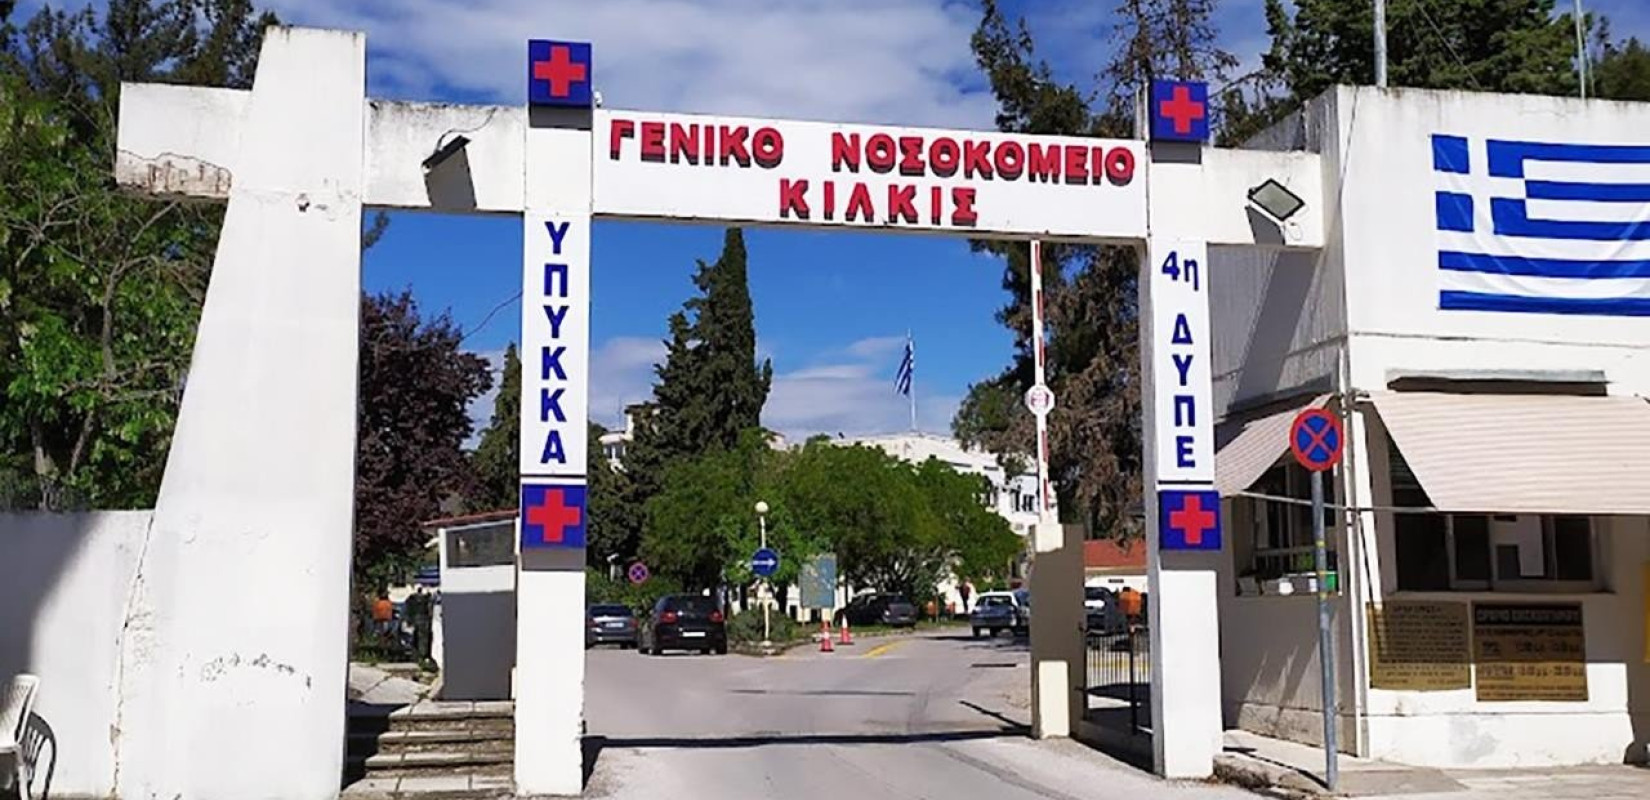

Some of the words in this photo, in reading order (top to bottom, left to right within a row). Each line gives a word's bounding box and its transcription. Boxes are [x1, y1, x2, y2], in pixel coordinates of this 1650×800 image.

[610, 119, 784, 169] ΓΕΝΙΚΟ
[832, 132, 1136, 186] ΝΟΣΟΚΟΜΕΙΟ
[779, 178, 978, 227] ΚΙΛΚΙΣ
[1162, 251, 1199, 291] 4η
[540, 221, 570, 464] ΥΠΥΚΚΑ
[1172, 314, 1195, 468] ΔΥΠΕ
